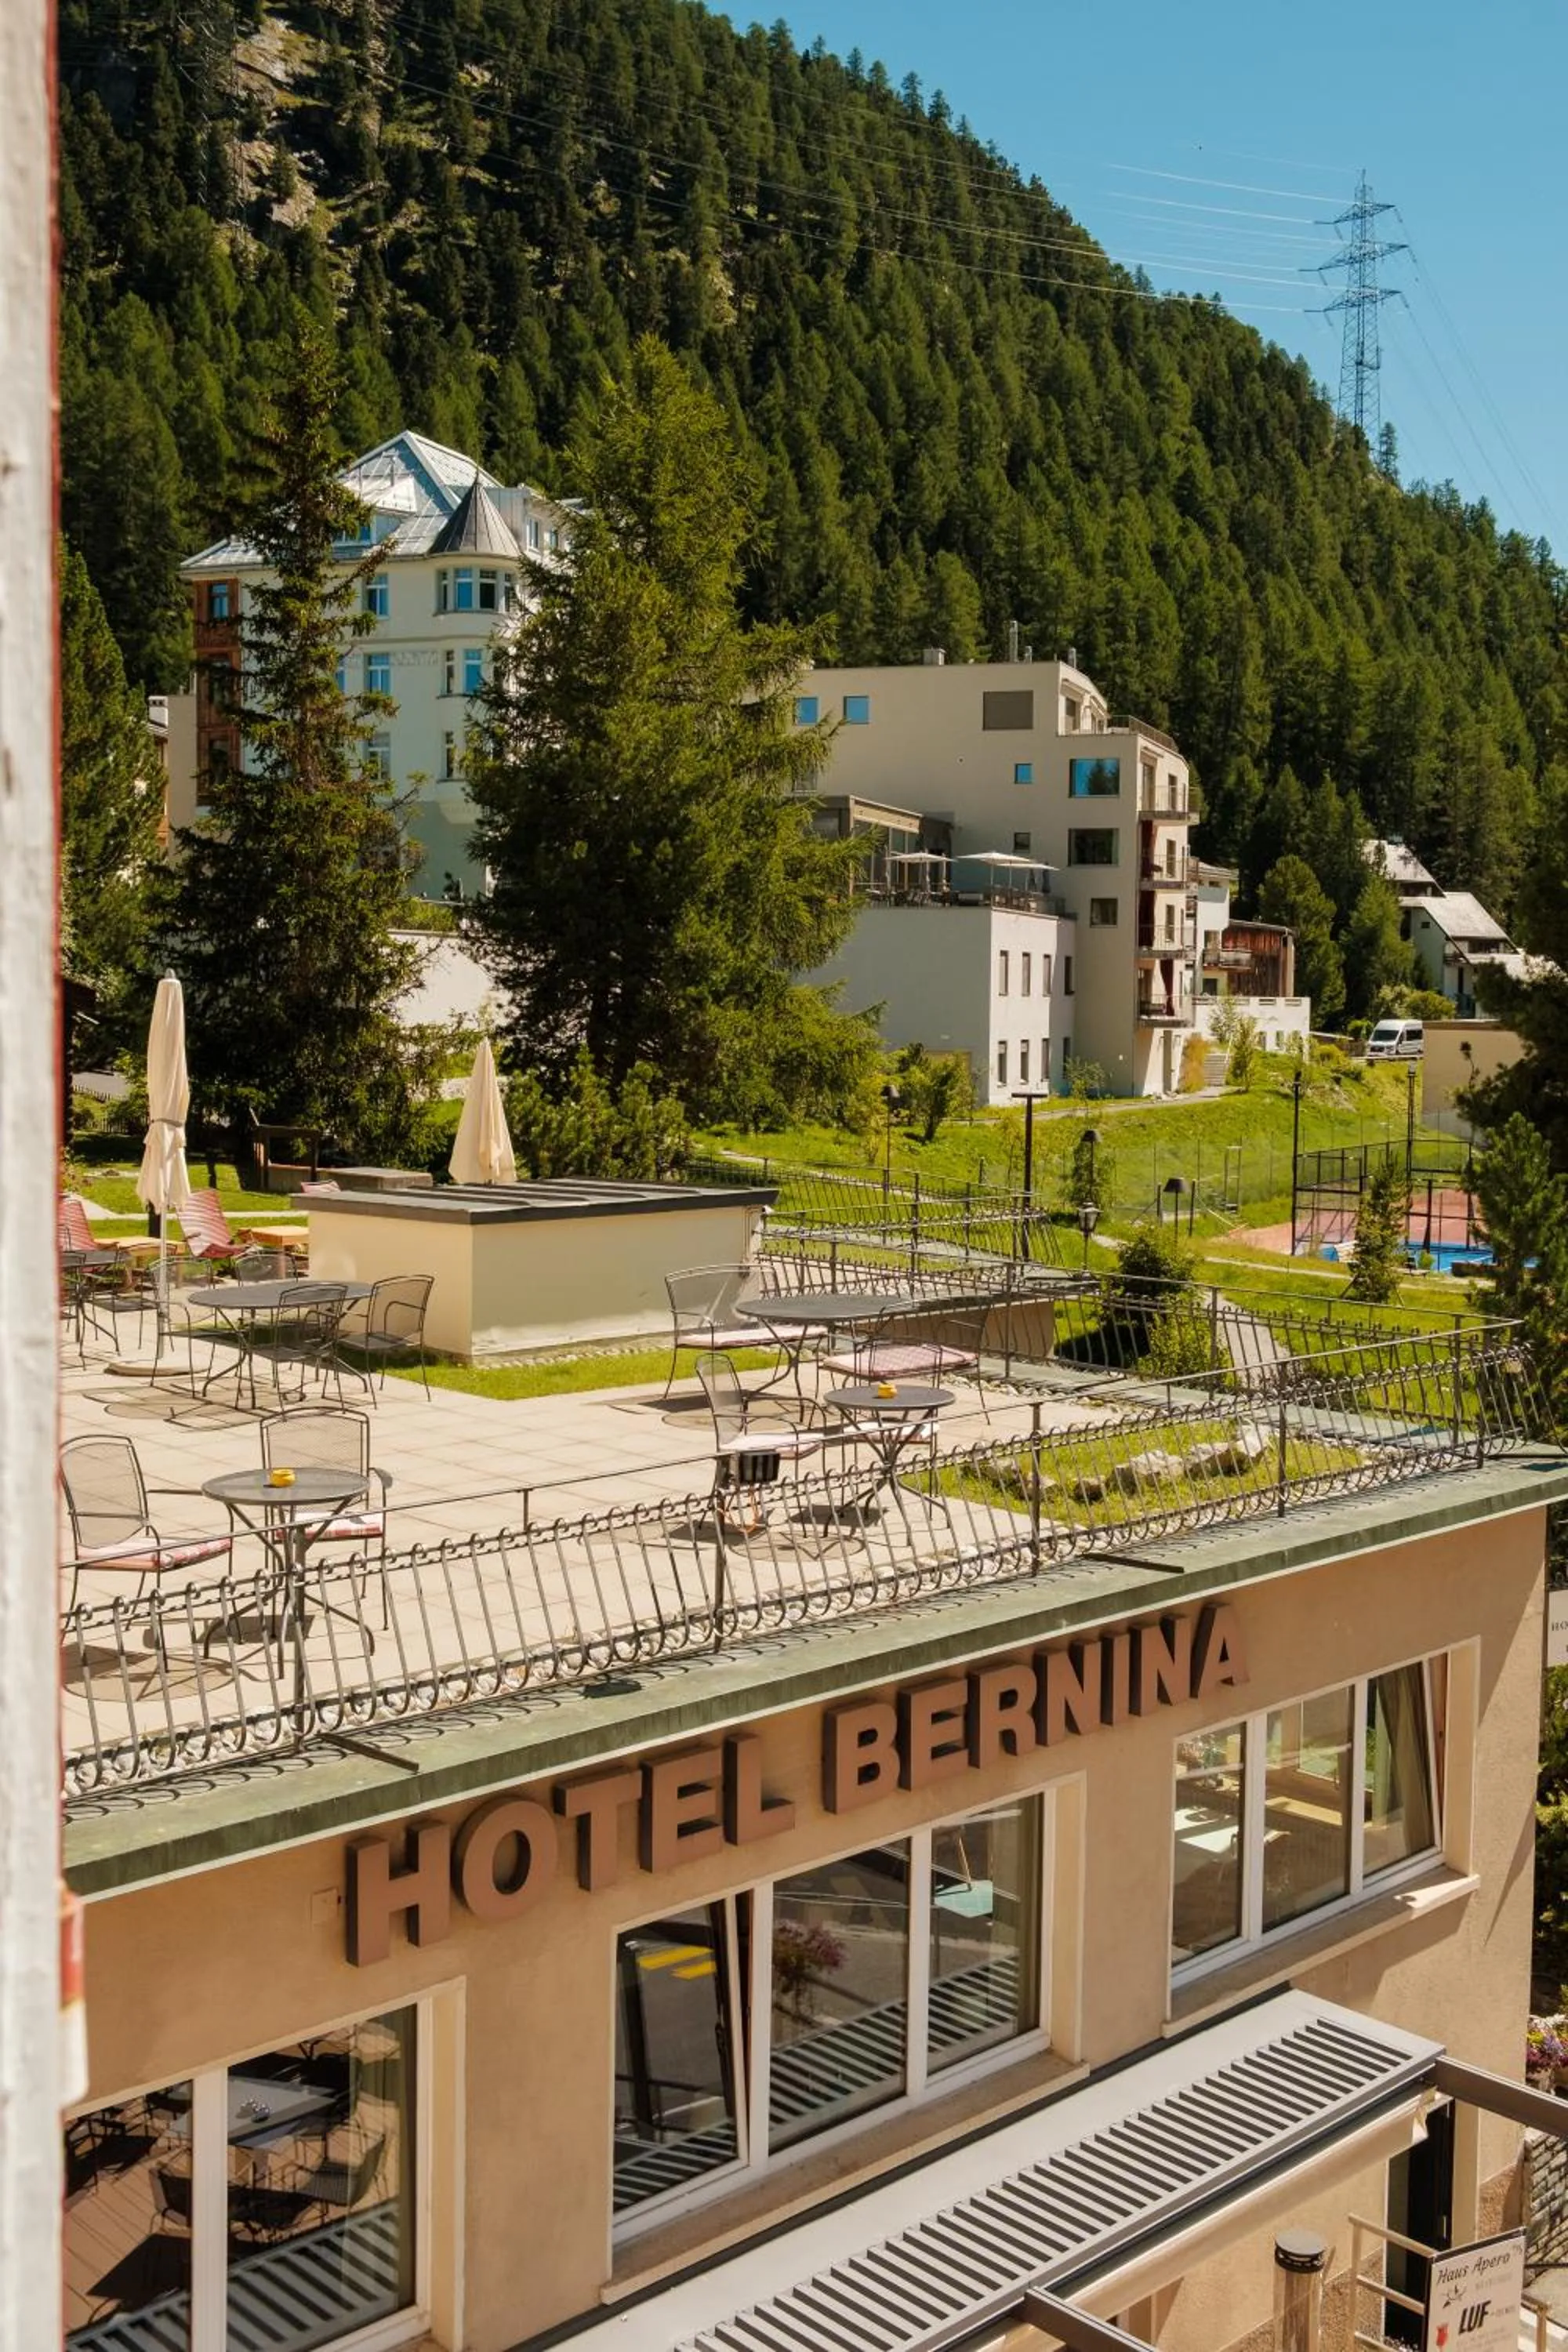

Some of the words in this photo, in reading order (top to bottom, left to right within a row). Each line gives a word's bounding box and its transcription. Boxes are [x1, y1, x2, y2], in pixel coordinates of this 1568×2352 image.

[346, 1733, 794, 1967] HOTEL
[823, 1602, 1250, 1813] BERNINA
[1436, 2264, 1469, 2285] Haus
[1458, 2300, 1492, 2336] LUF
